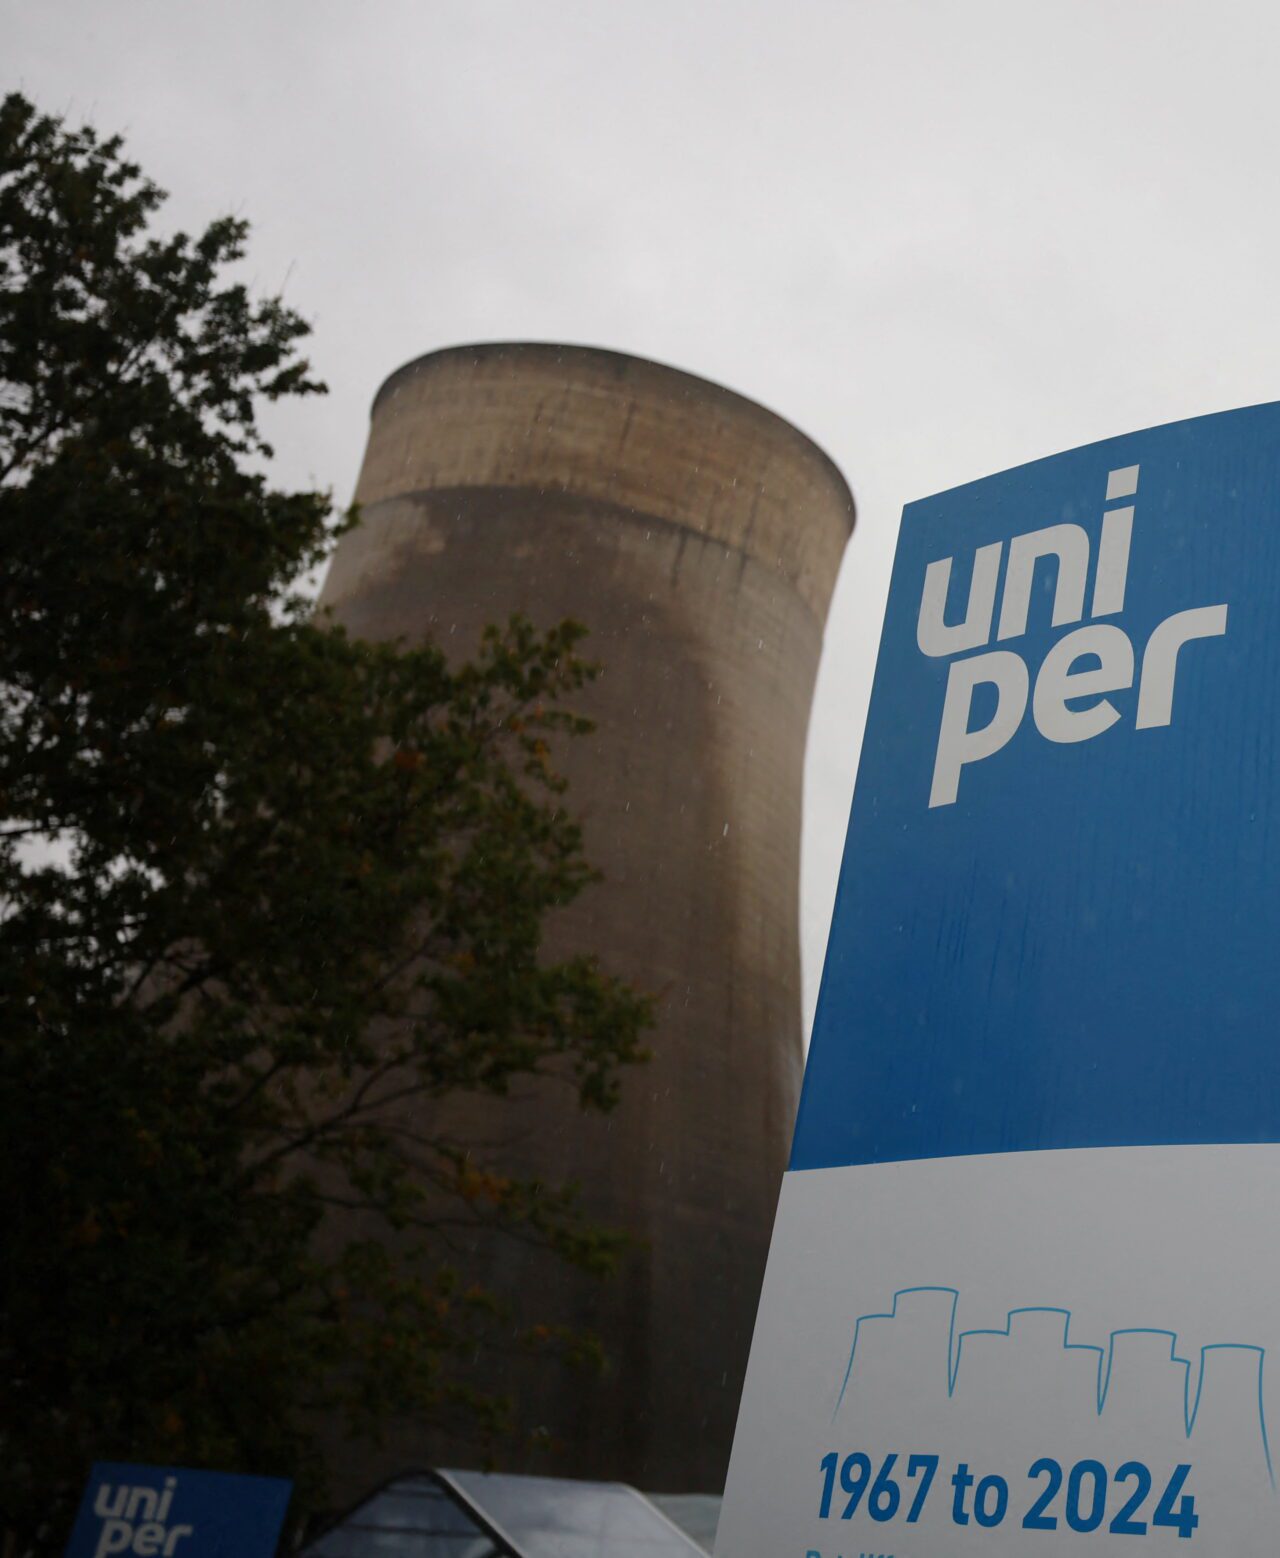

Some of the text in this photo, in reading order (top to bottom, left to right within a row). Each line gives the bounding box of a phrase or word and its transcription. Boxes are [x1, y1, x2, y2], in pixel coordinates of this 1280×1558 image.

[917, 464, 1140, 658] uni
[928, 603, 1229, 809] per
[93, 1476, 178, 1521] uni
[818, 1452, 1199, 1538] 1967 to 2024
[93, 1519, 193, 1558] per
